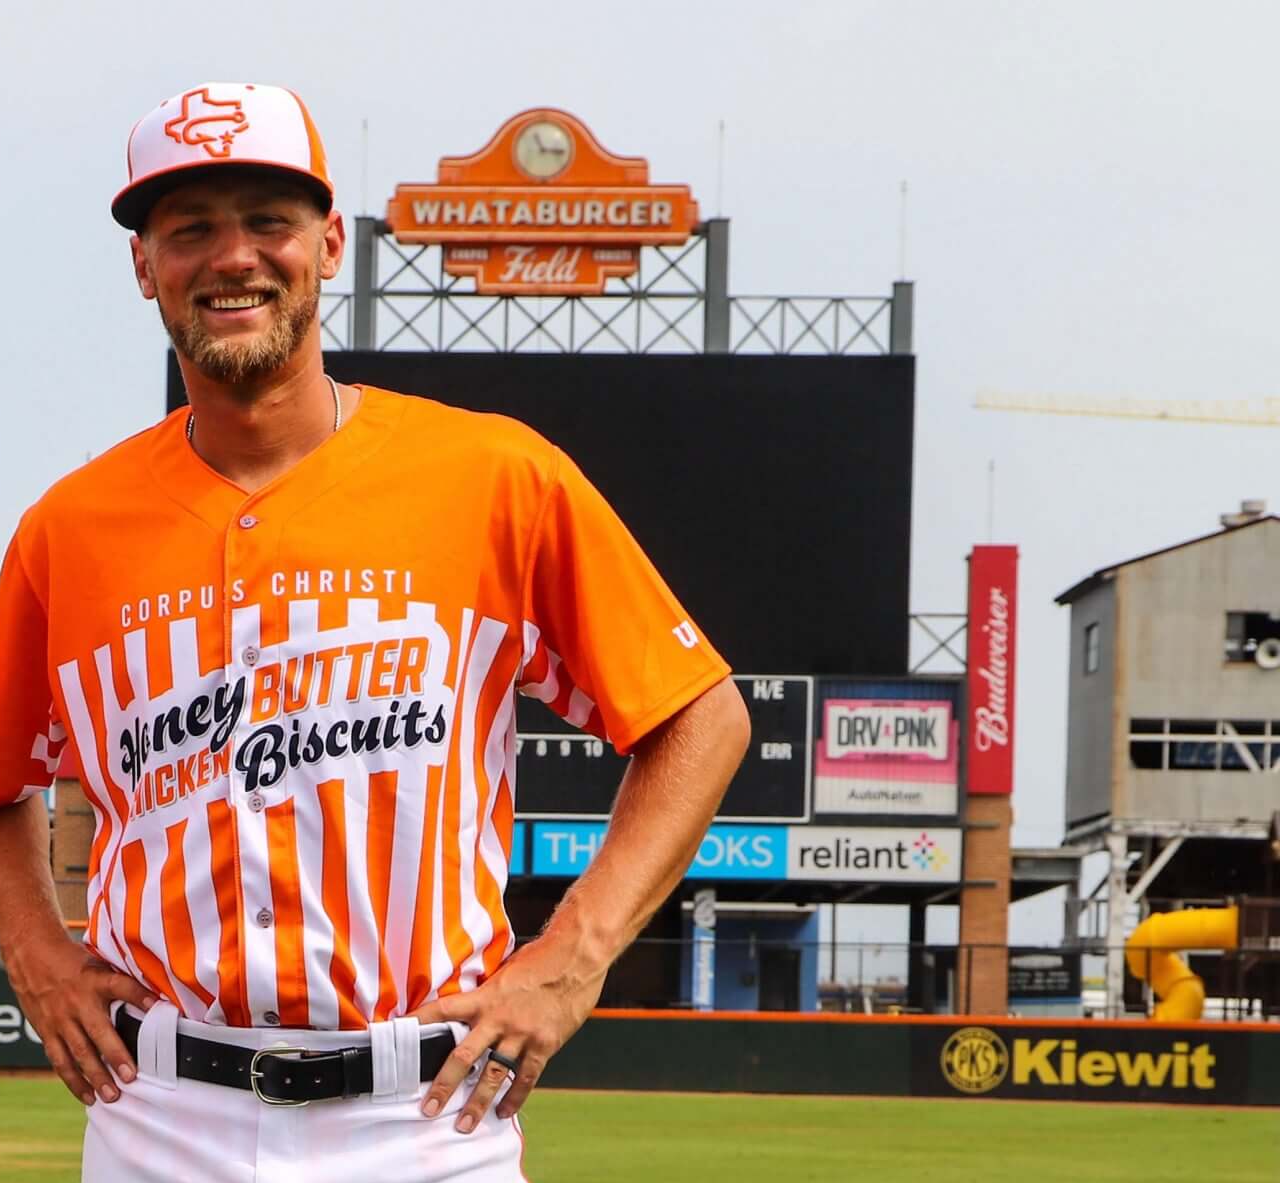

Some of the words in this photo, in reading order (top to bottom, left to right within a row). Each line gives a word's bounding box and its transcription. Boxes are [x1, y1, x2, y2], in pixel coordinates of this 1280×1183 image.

[411, 199, 672, 226] WHATABURGER
[499, 245, 582, 283] Field
[121, 578, 245, 628] CORPUS
[271, 568, 412, 597] CHRISTI
[975, 586, 1009, 752] Budweiser
[120, 676, 247, 795] Honey
[249, 636, 431, 726] BUTTER
[837, 715, 882, 746] DRV
[894, 716, 937, 747] PNK
[235, 700, 447, 793] Biscuits
[583, 740, 604, 758] 10
[799, 838, 908, 870] reliant
[1013, 1038, 1216, 1089] Kiewit
